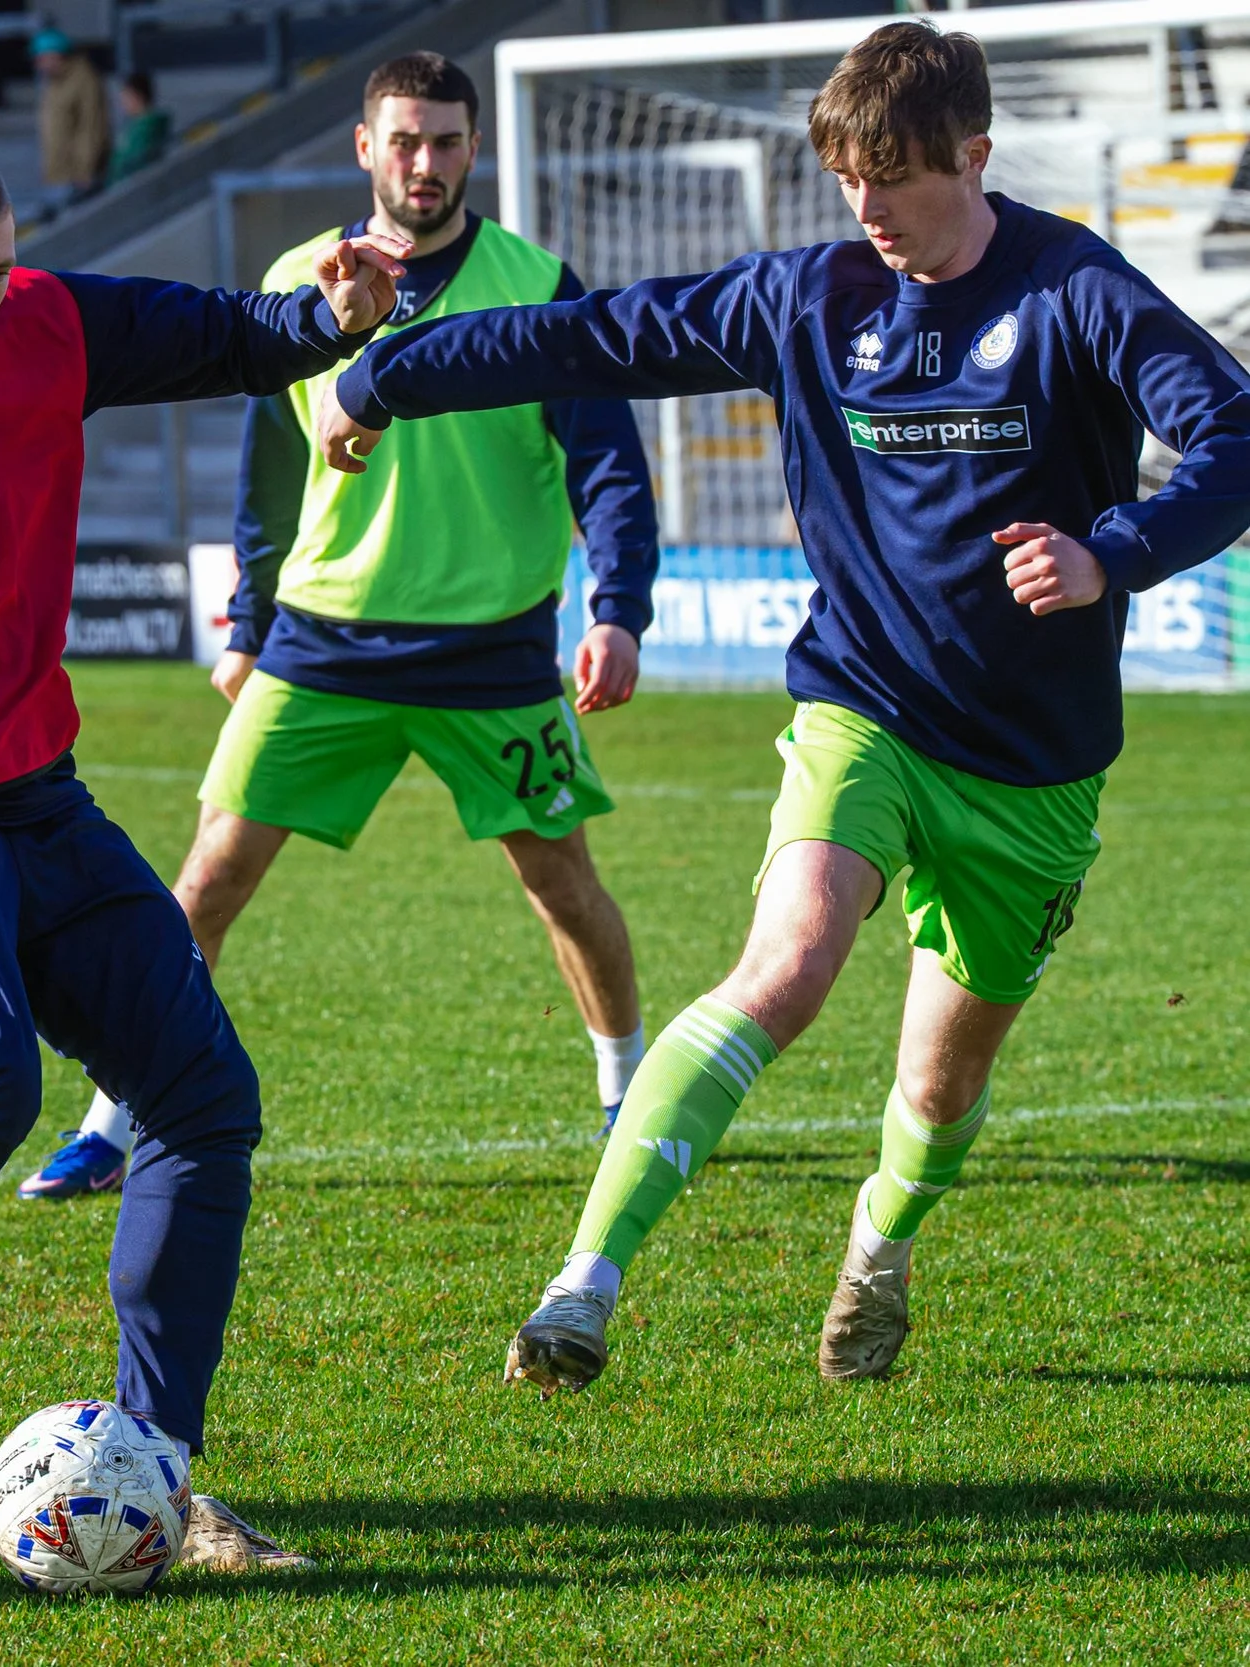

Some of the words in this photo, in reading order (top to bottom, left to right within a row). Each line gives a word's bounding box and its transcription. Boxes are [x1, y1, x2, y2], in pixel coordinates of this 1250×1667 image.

[916, 331, 942, 377] 18
[850, 417, 1025, 445] enterprise
[501, 717, 575, 800] 25
